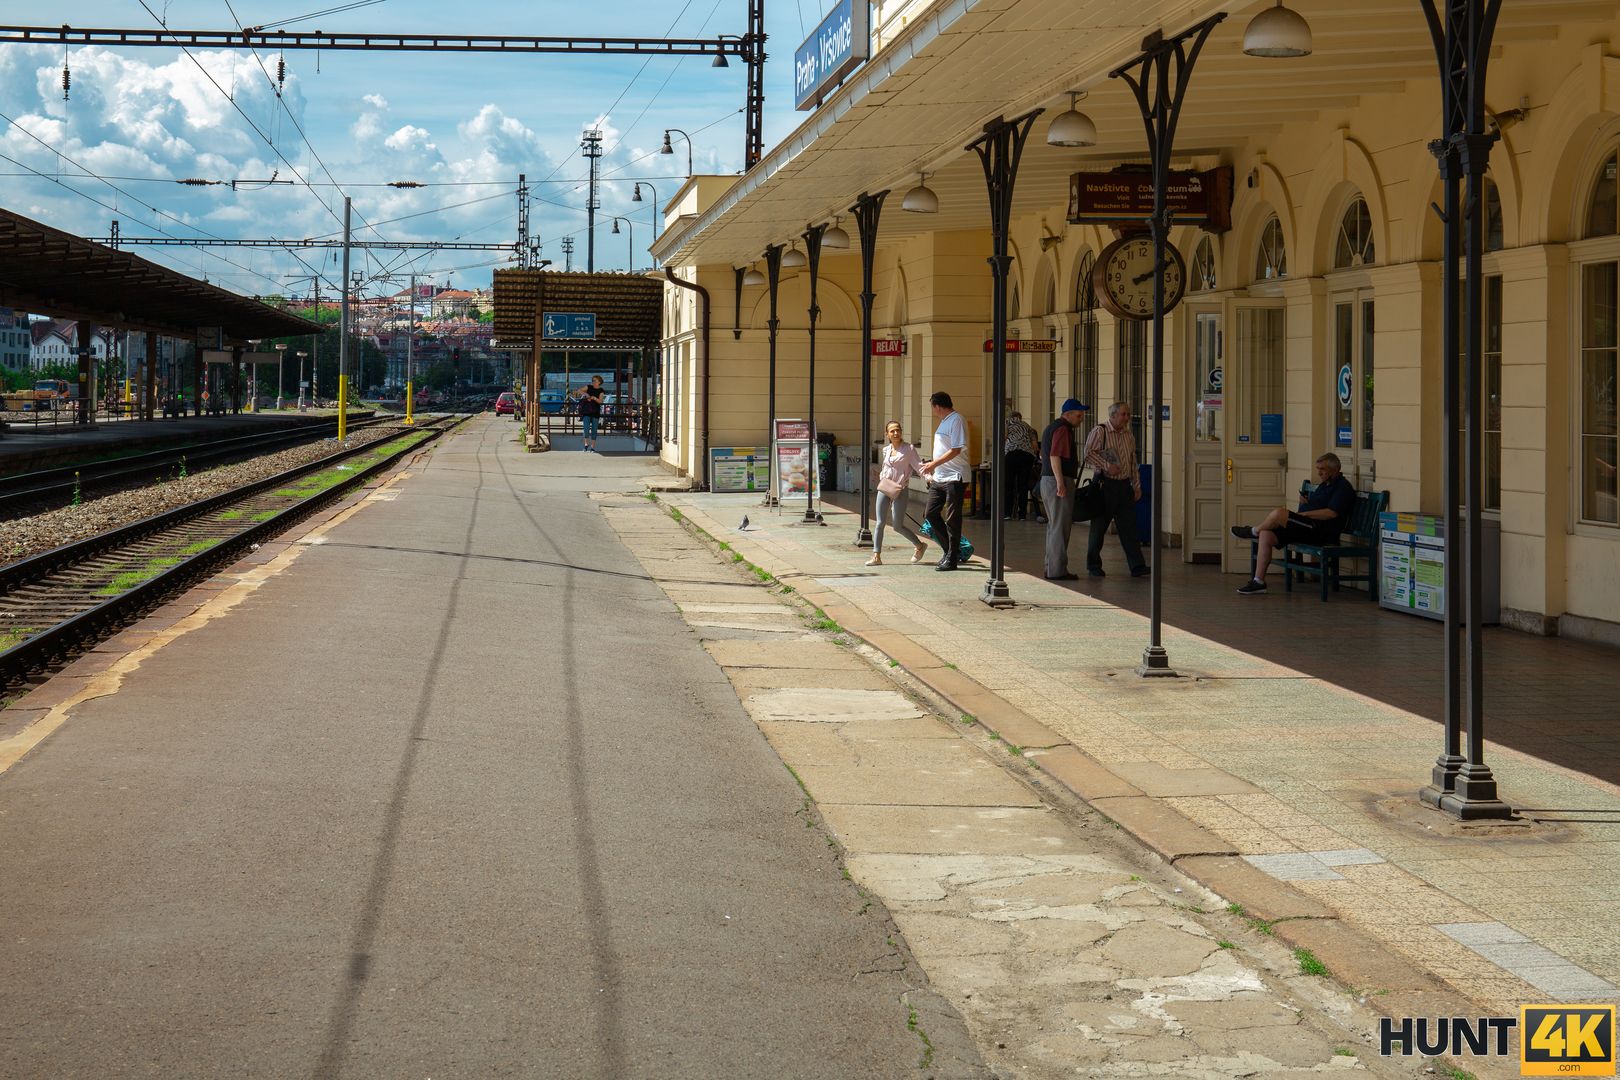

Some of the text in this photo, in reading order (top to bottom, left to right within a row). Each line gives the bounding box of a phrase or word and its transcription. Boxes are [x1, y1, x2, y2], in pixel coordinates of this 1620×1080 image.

[797, 52, 815, 96] Praha
[820, 16, 851, 72] Vršovice
[1087, 183, 1130, 192] Navštivte
[1127, 251, 1135, 261] 11
[1139, 247, 1148, 257] 12
[1118, 260, 1127, 270] 10
[1115, 272, 1122, 283] 9
[1164, 272, 1172, 283] 3
[1118, 284, 1125, 295] 8
[1127, 294, 1134, 305] 7
[1139, 297, 1146, 308] 6
[876, 340, 899, 353] RELAY
